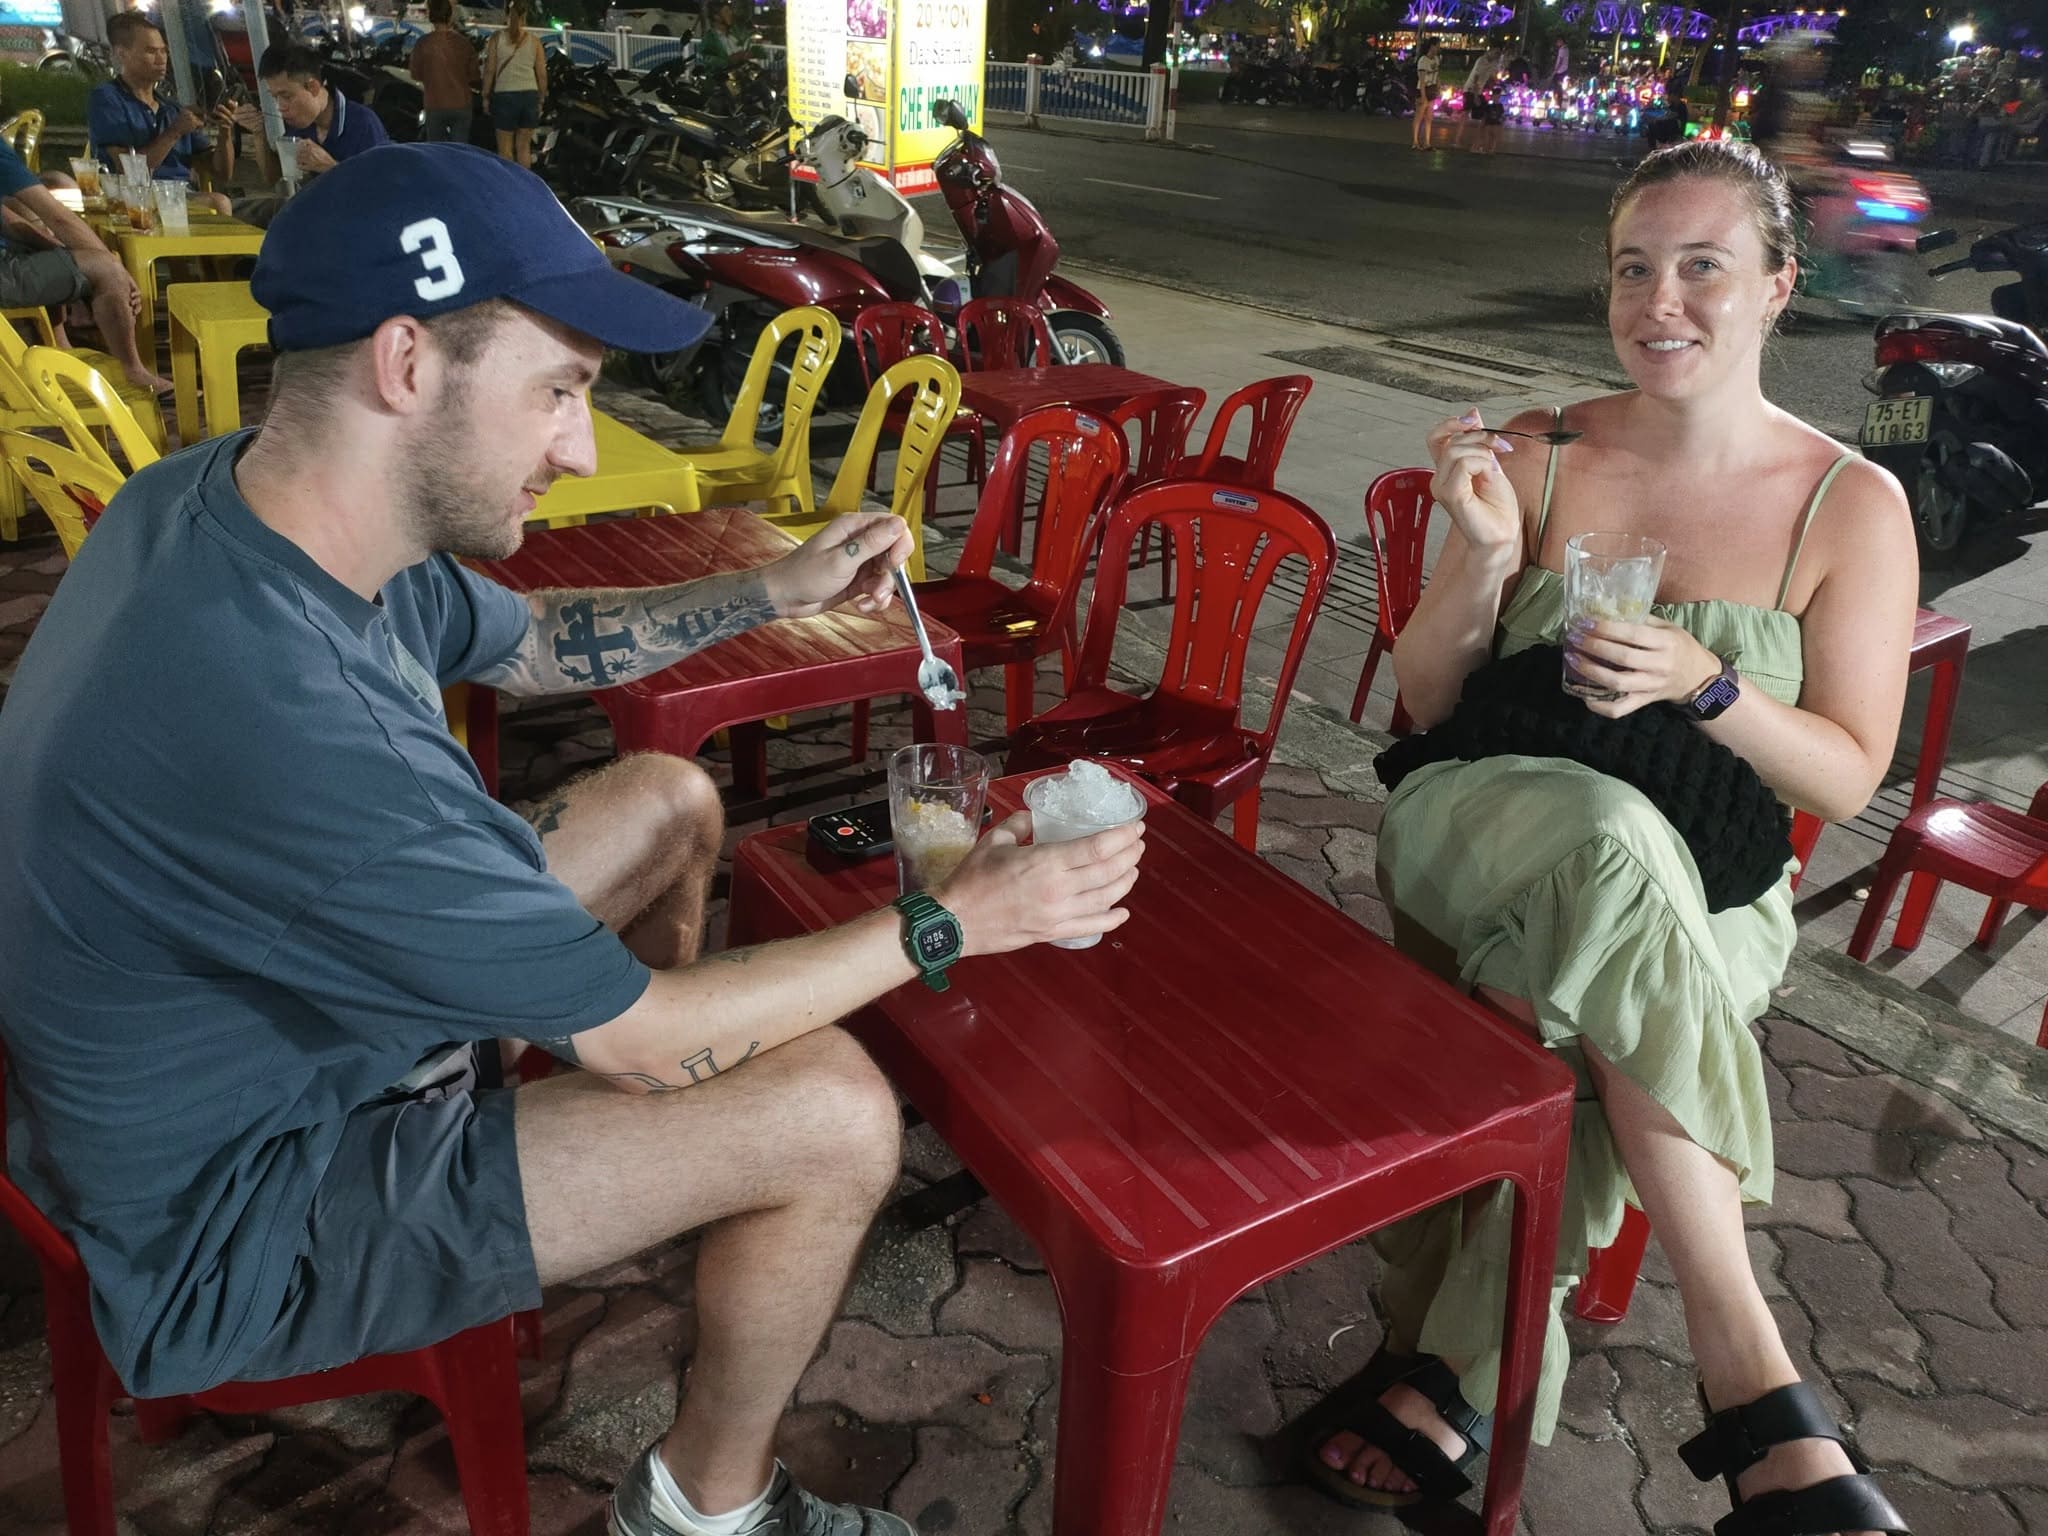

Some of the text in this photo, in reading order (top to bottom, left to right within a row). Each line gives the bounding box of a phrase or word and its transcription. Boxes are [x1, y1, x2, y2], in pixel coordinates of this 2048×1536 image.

[916, 3, 932, 28] 20
[399, 217, 465, 302] 3
[1876, 401, 1921, 422] 75-E1
[1868, 423, 1924, 443] 11863
